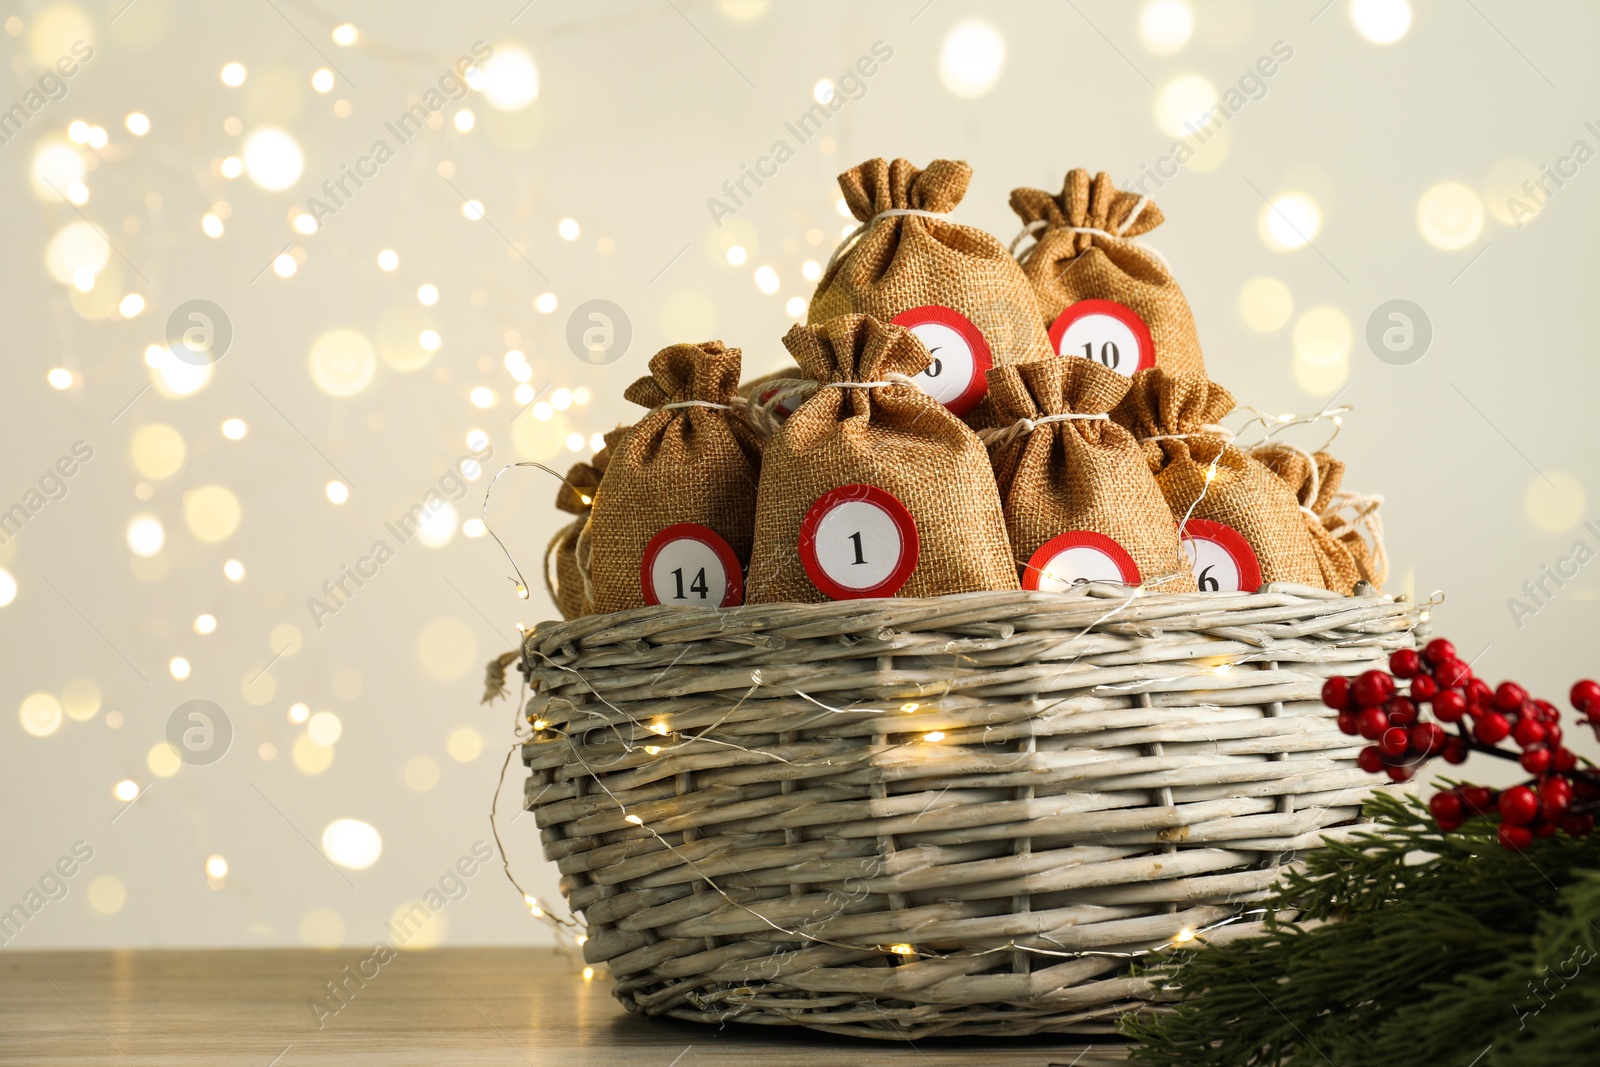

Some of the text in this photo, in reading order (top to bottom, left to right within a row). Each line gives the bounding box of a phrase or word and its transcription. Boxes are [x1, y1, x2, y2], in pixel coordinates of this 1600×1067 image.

[1081, 341, 1120, 370] 10
[848, 531, 868, 566] 1
[671, 567, 708, 599] 14
[1198, 564, 1219, 592] 6
